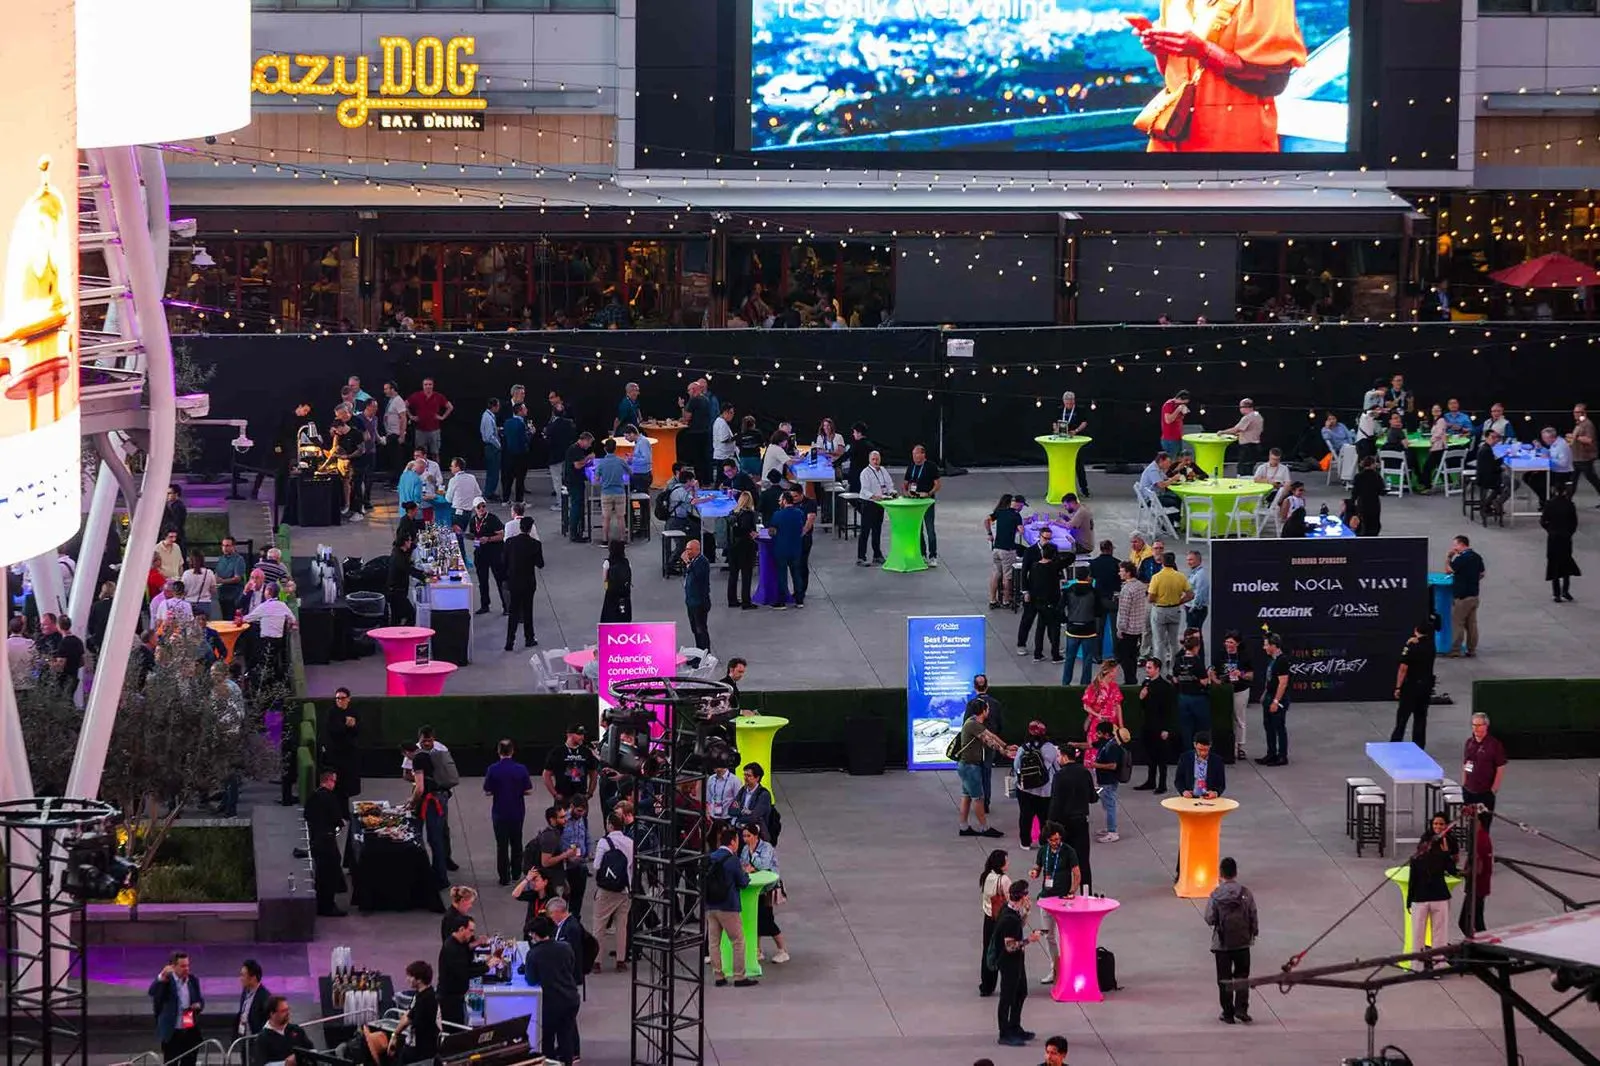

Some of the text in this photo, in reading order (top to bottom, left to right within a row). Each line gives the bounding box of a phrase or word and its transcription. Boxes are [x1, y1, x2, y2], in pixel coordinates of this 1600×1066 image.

[251, 35, 479, 128] azy DOG
[381, 115, 480, 128] EAT. DRINK.
[1232, 579, 1280, 592] molex
[1295, 579, 1344, 591] NOKIA
[1358, 578, 1408, 589] VIAVI
[1257, 606, 1314, 618] Accelink
[1344, 603, 1379, 613] O-Net
[608, 634, 652, 645] NOKIA
[608, 655, 652, 664] Advancing
[608, 666, 659, 676] connectivity
